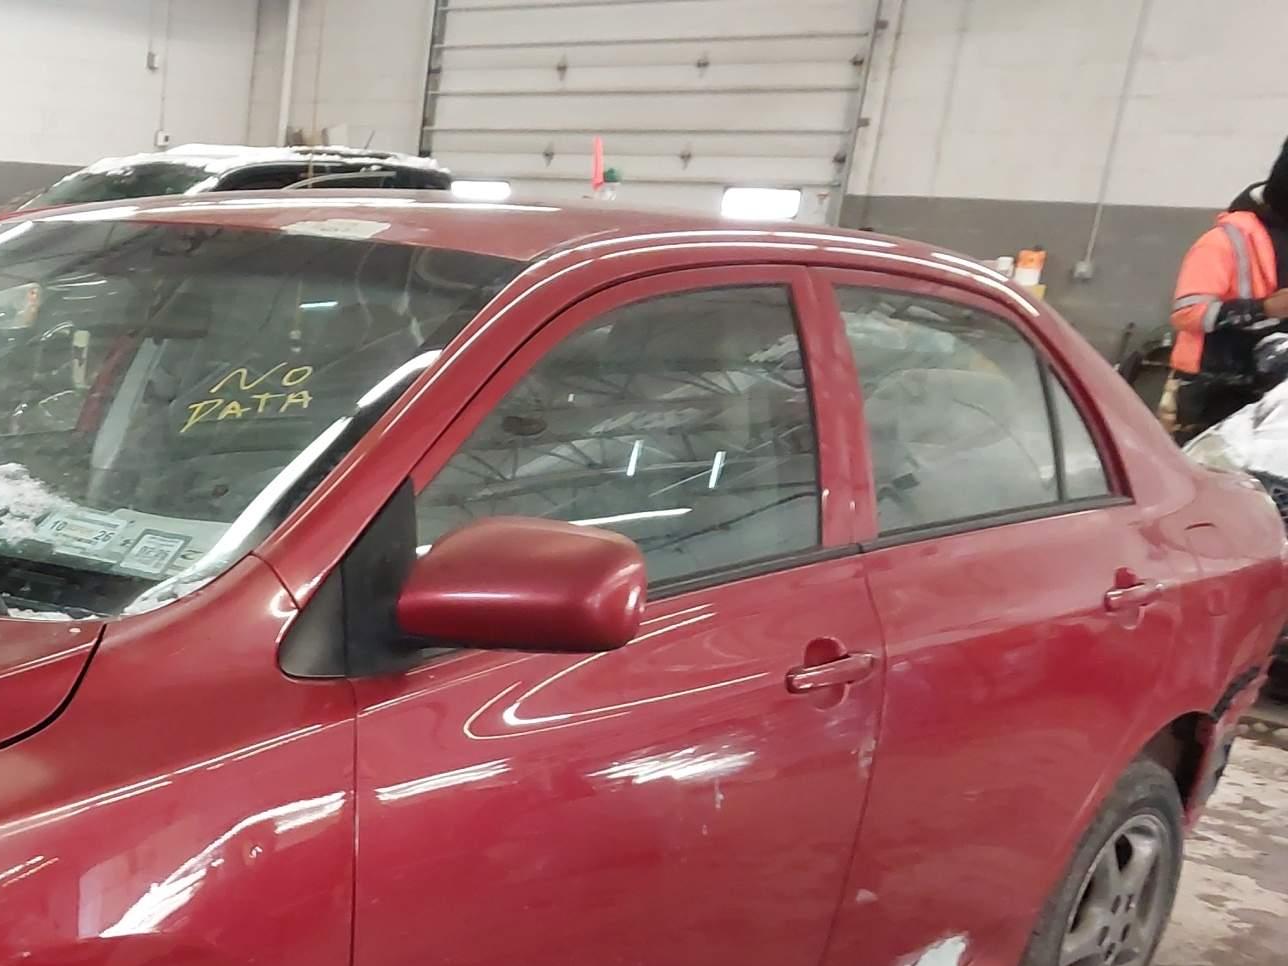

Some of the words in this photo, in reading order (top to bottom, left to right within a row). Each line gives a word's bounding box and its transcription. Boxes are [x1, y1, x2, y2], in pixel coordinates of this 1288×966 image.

[209, 361, 313, 393] NO
[179, 390, 313, 433] DATA
[50, 520, 68, 532] 10
[93, 530, 116, 542] 26
